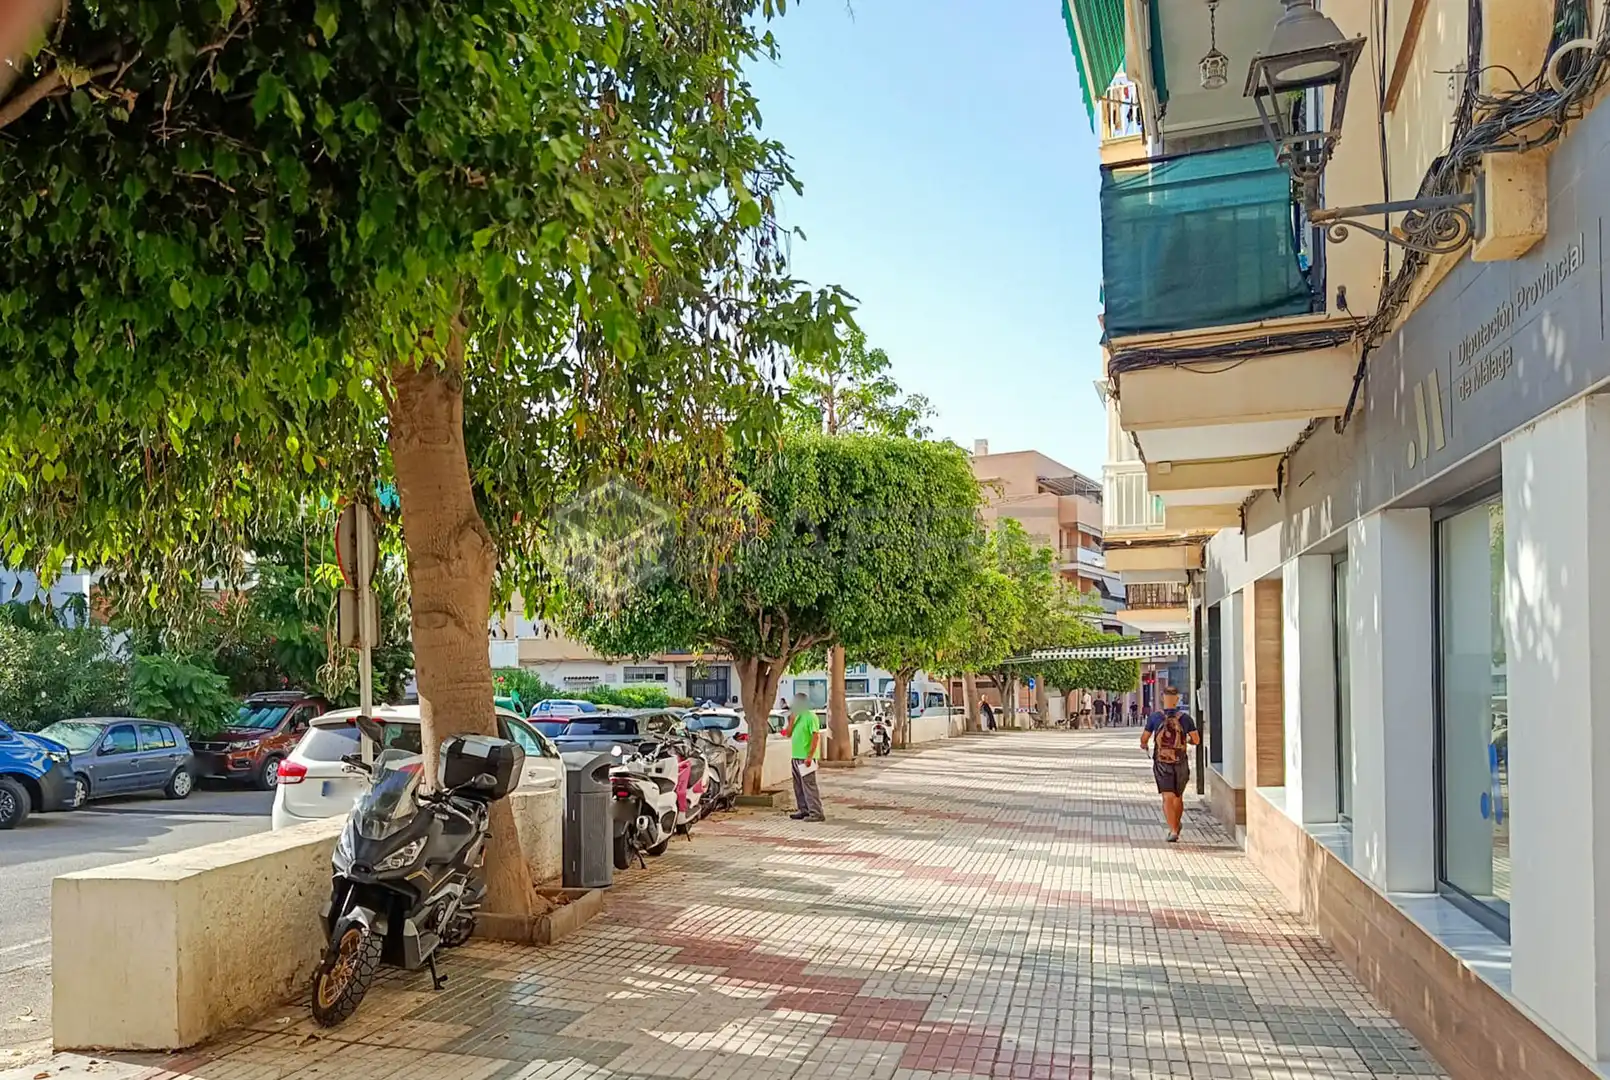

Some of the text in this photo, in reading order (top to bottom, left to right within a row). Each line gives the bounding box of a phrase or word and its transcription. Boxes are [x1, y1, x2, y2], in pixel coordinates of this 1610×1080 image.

[1458, 232, 1585, 367] Diputación Provincial
[1459, 345, 1513, 401] de Málaga
